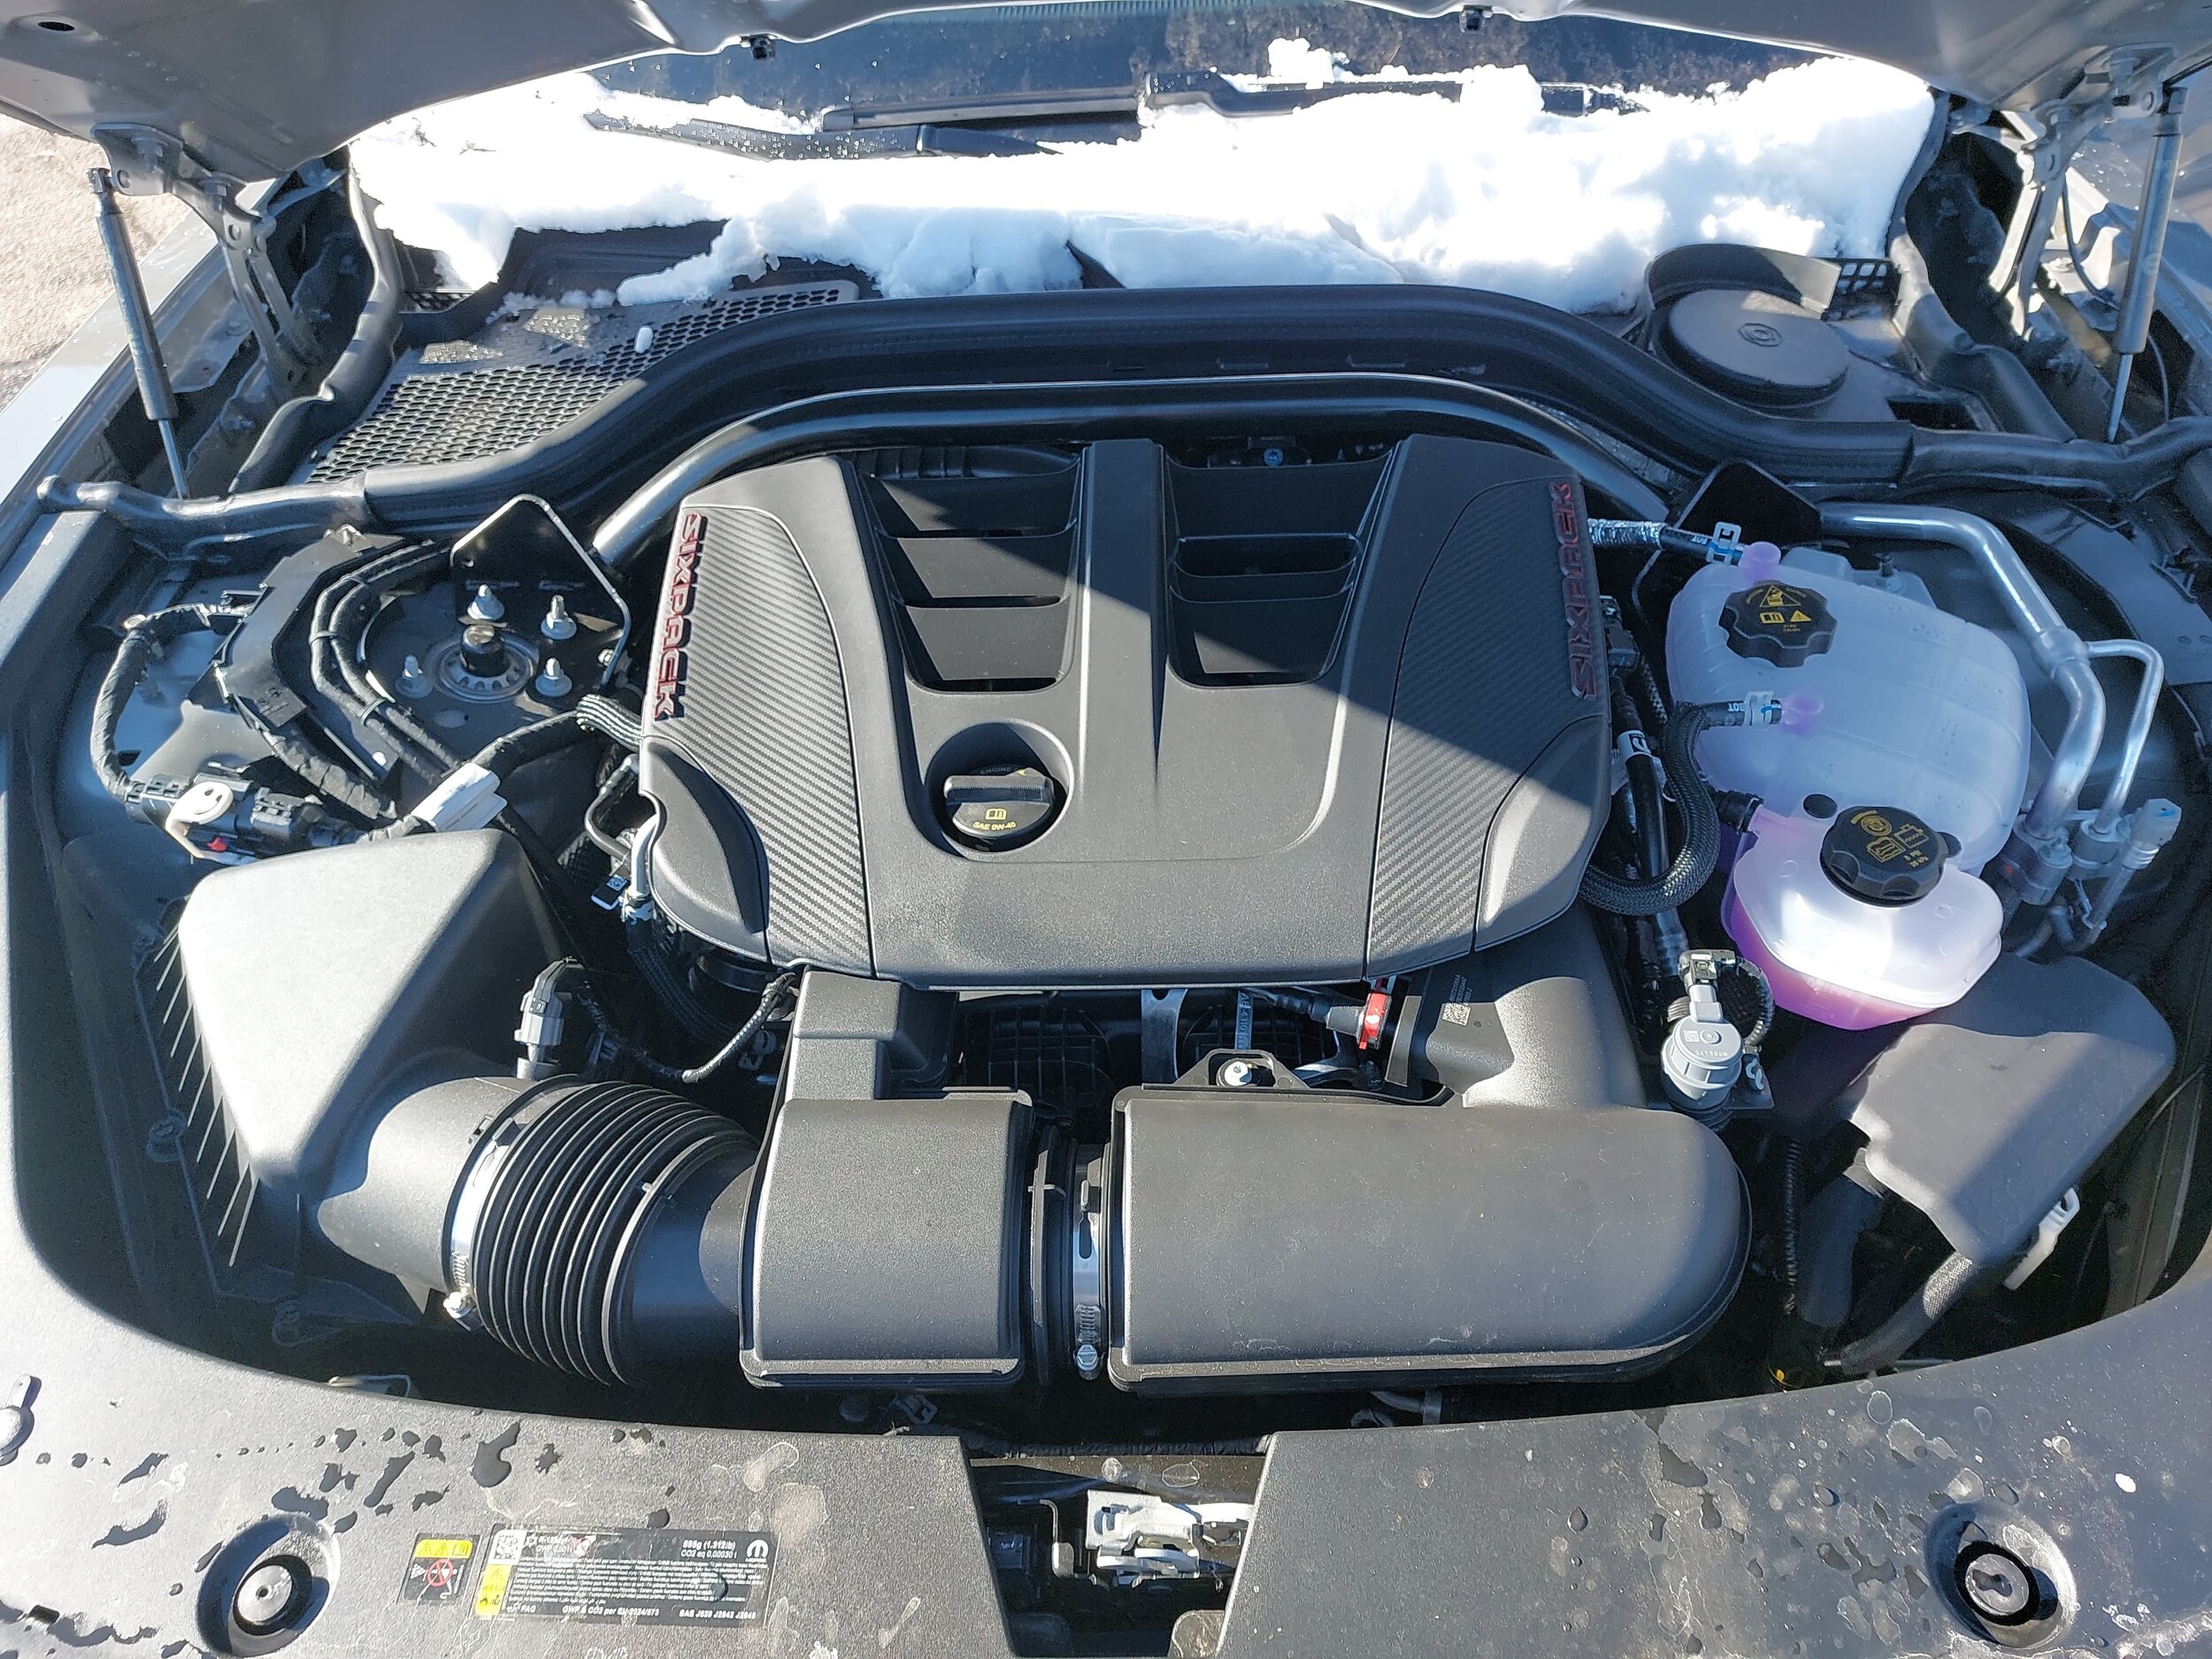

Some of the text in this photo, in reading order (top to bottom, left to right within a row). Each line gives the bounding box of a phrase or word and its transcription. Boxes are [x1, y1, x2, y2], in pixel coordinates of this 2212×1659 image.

[654, 512, 703, 721] SIXPACK
[1550, 483, 1597, 698] SIXPACK
[972, 821, 1017, 831] SAE 0W-40
[680, 1549, 696, 1558] CO2
